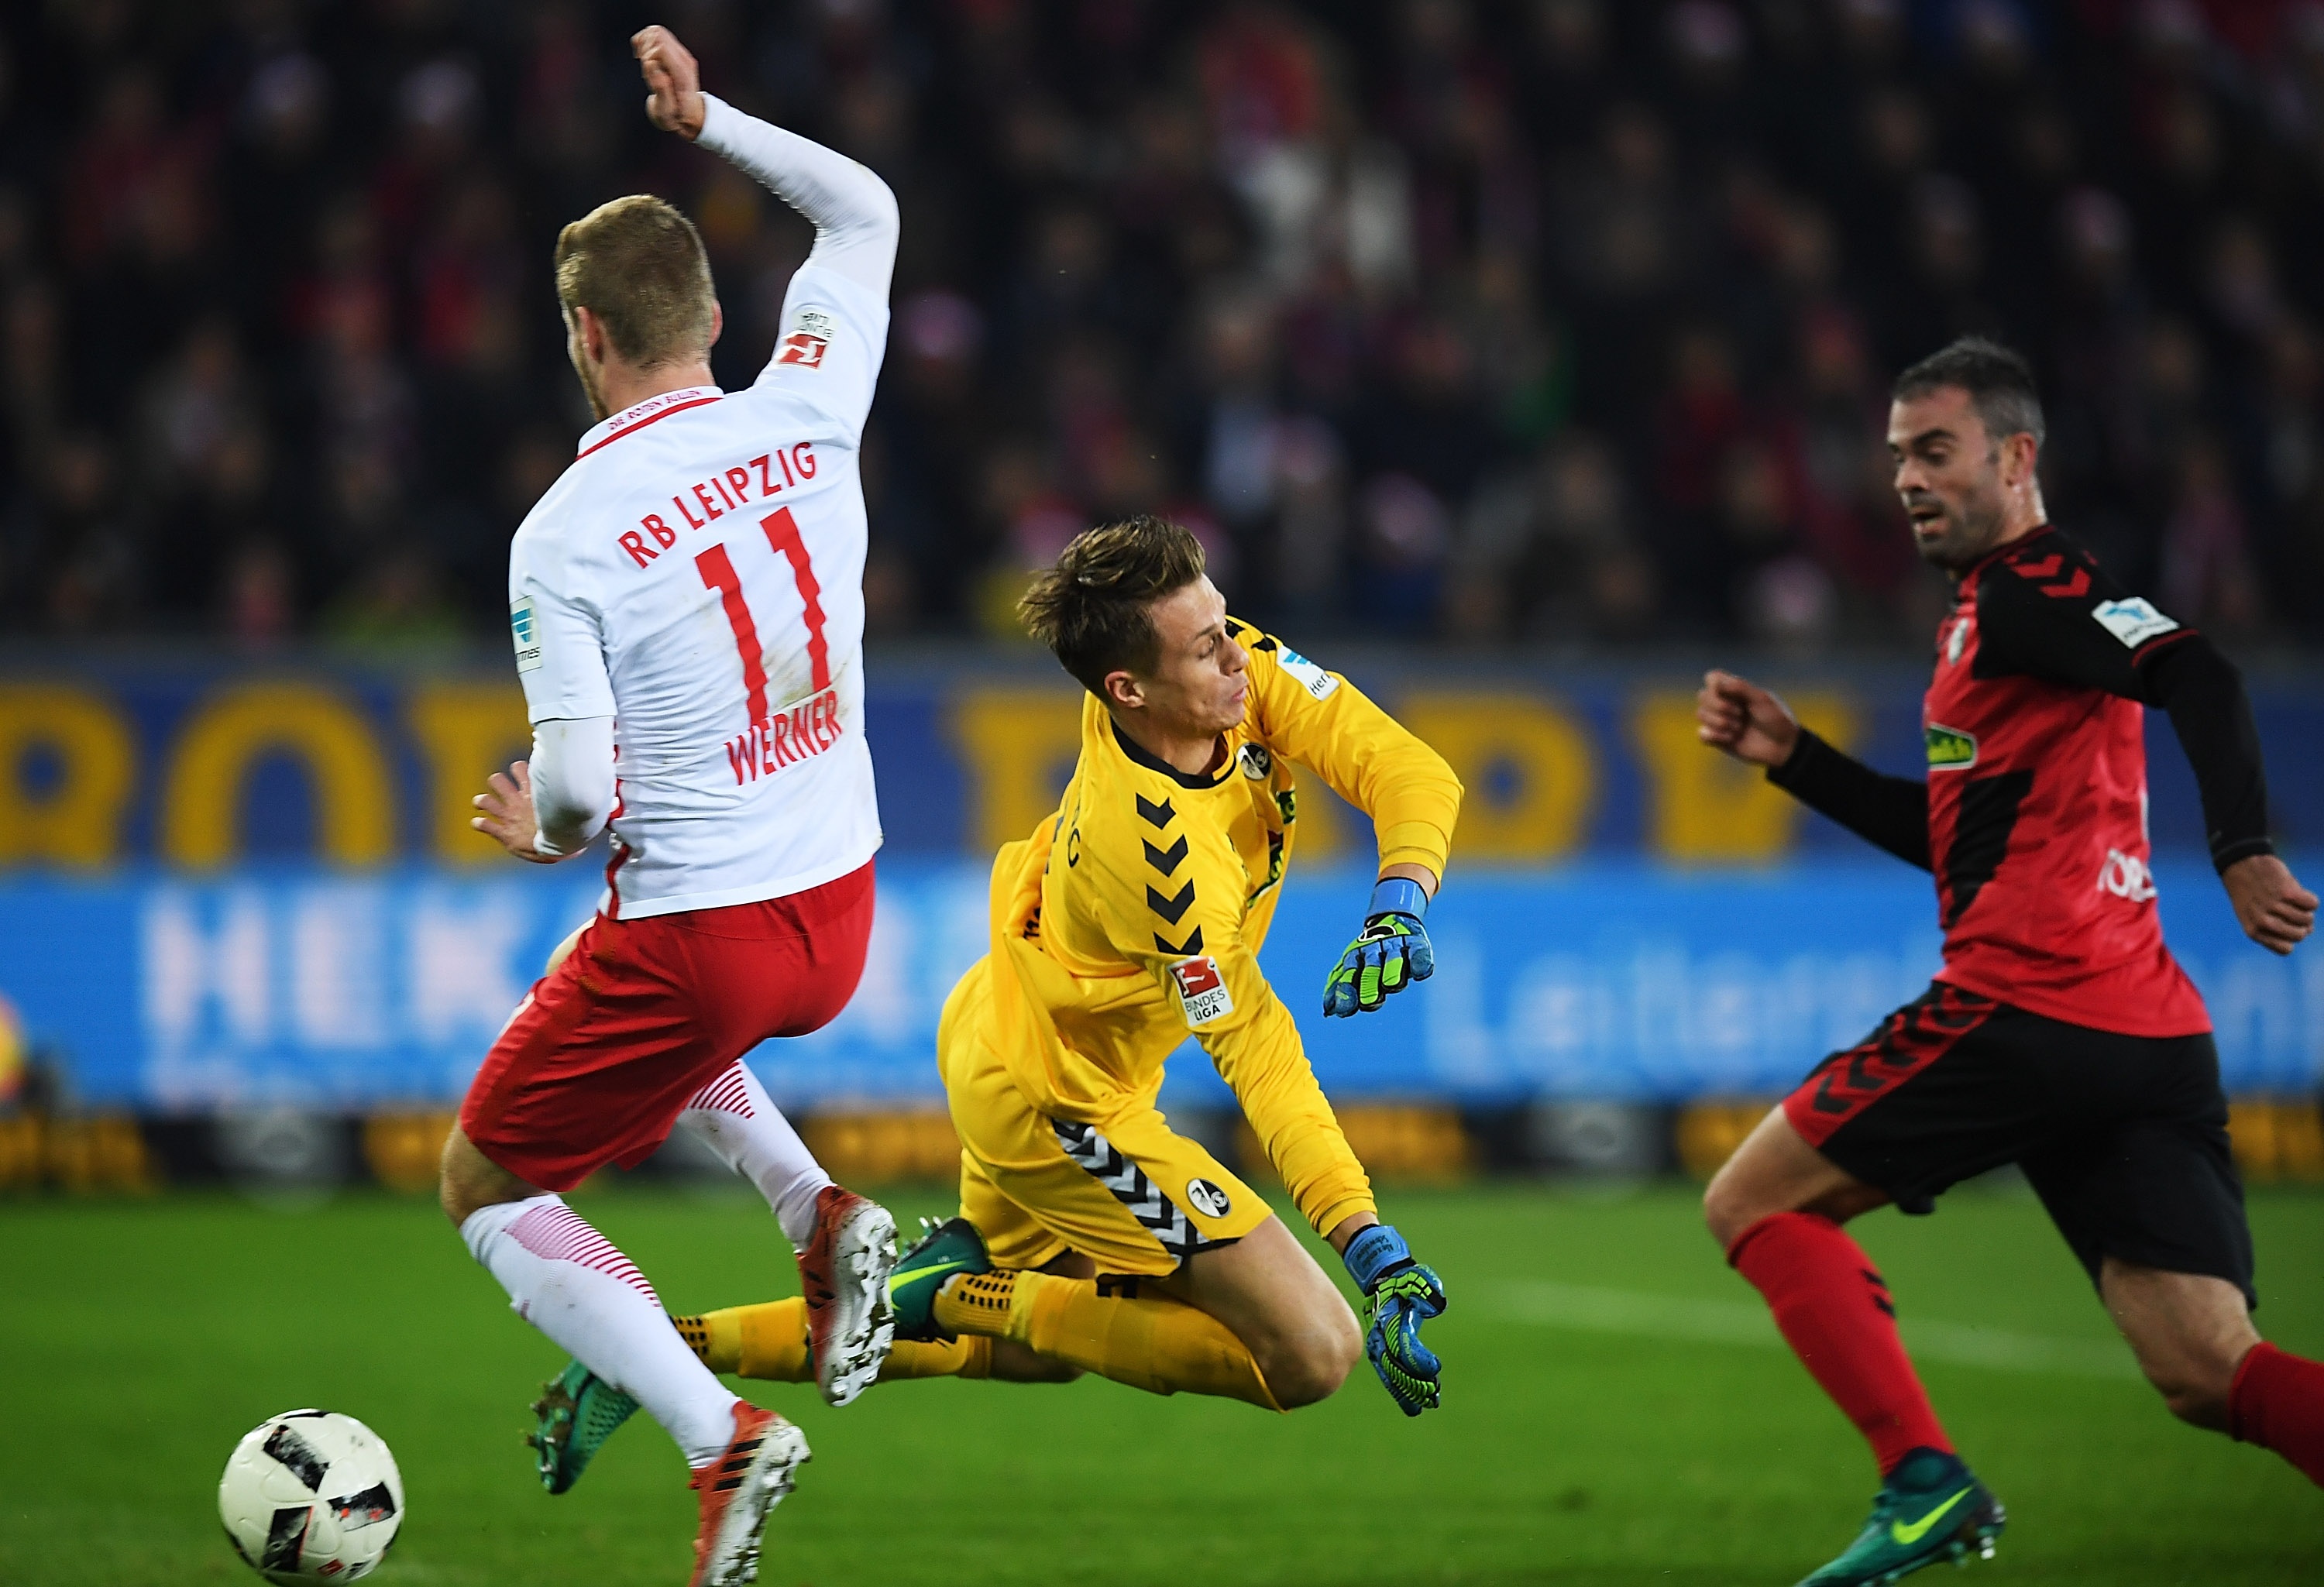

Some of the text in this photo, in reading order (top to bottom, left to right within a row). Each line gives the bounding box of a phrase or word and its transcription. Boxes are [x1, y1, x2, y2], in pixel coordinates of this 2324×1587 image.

[618, 441, 817, 569] RB LEIPZIG
[695, 506, 831, 726] 11
[725, 691, 843, 786] WERNER
